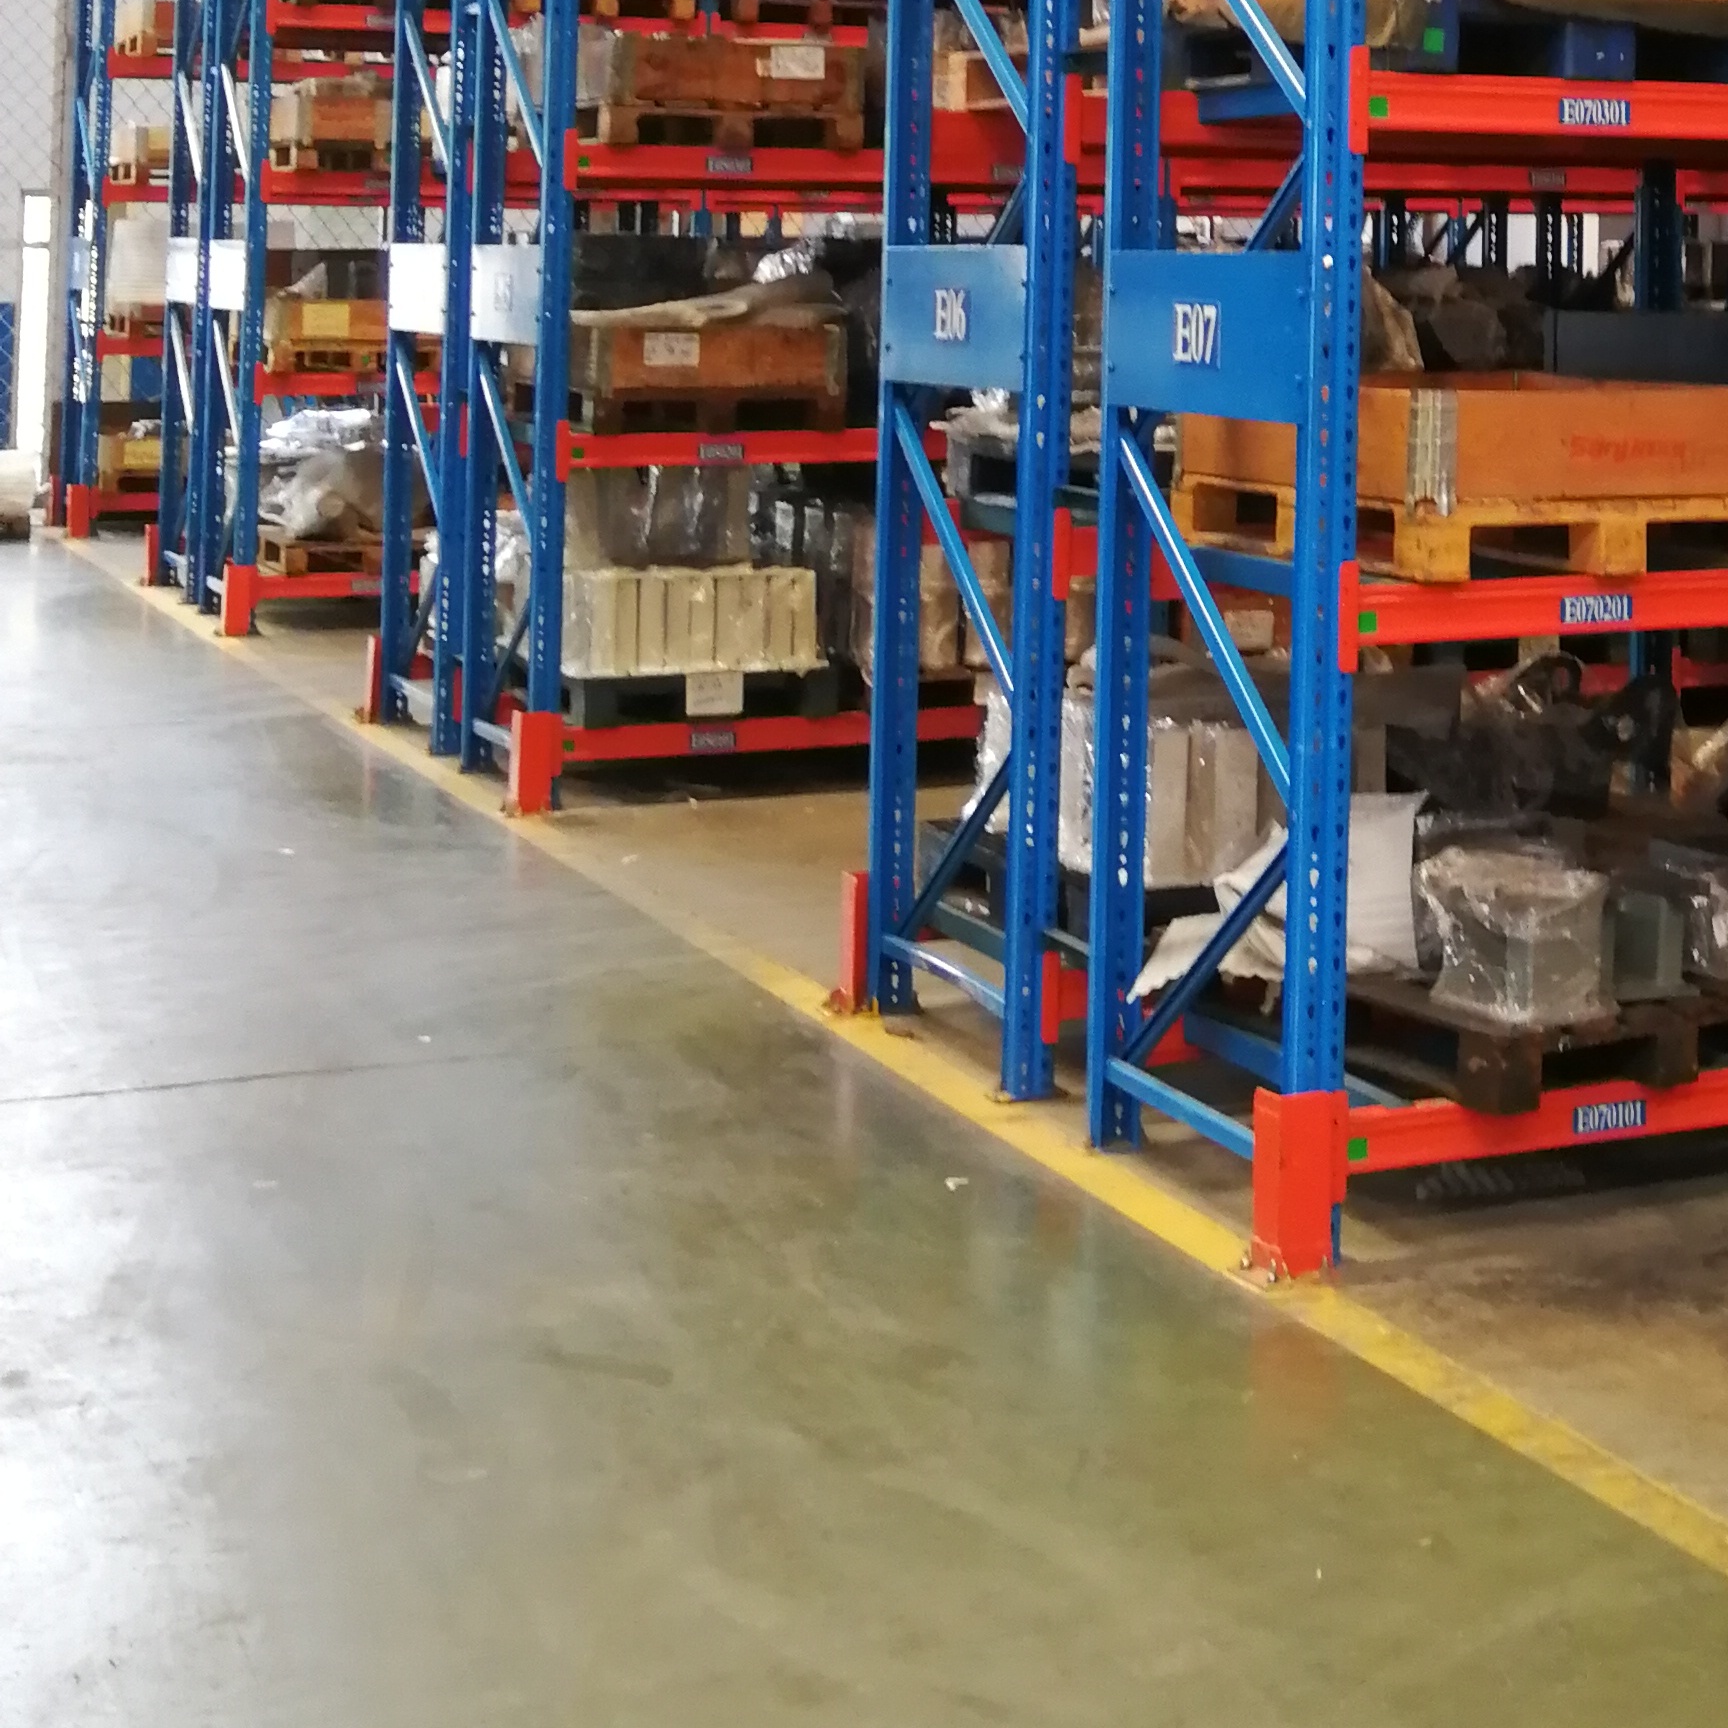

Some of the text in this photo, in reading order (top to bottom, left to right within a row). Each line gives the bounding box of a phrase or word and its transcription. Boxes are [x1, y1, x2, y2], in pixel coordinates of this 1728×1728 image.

[1561, 98, 1627, 127] E070301
[933, 288, 966, 341] E06
[1173, 303, 1216, 364] E07
[1563, 593, 1631, 624] E070201
[1575, 1098, 1643, 1134] E070101
